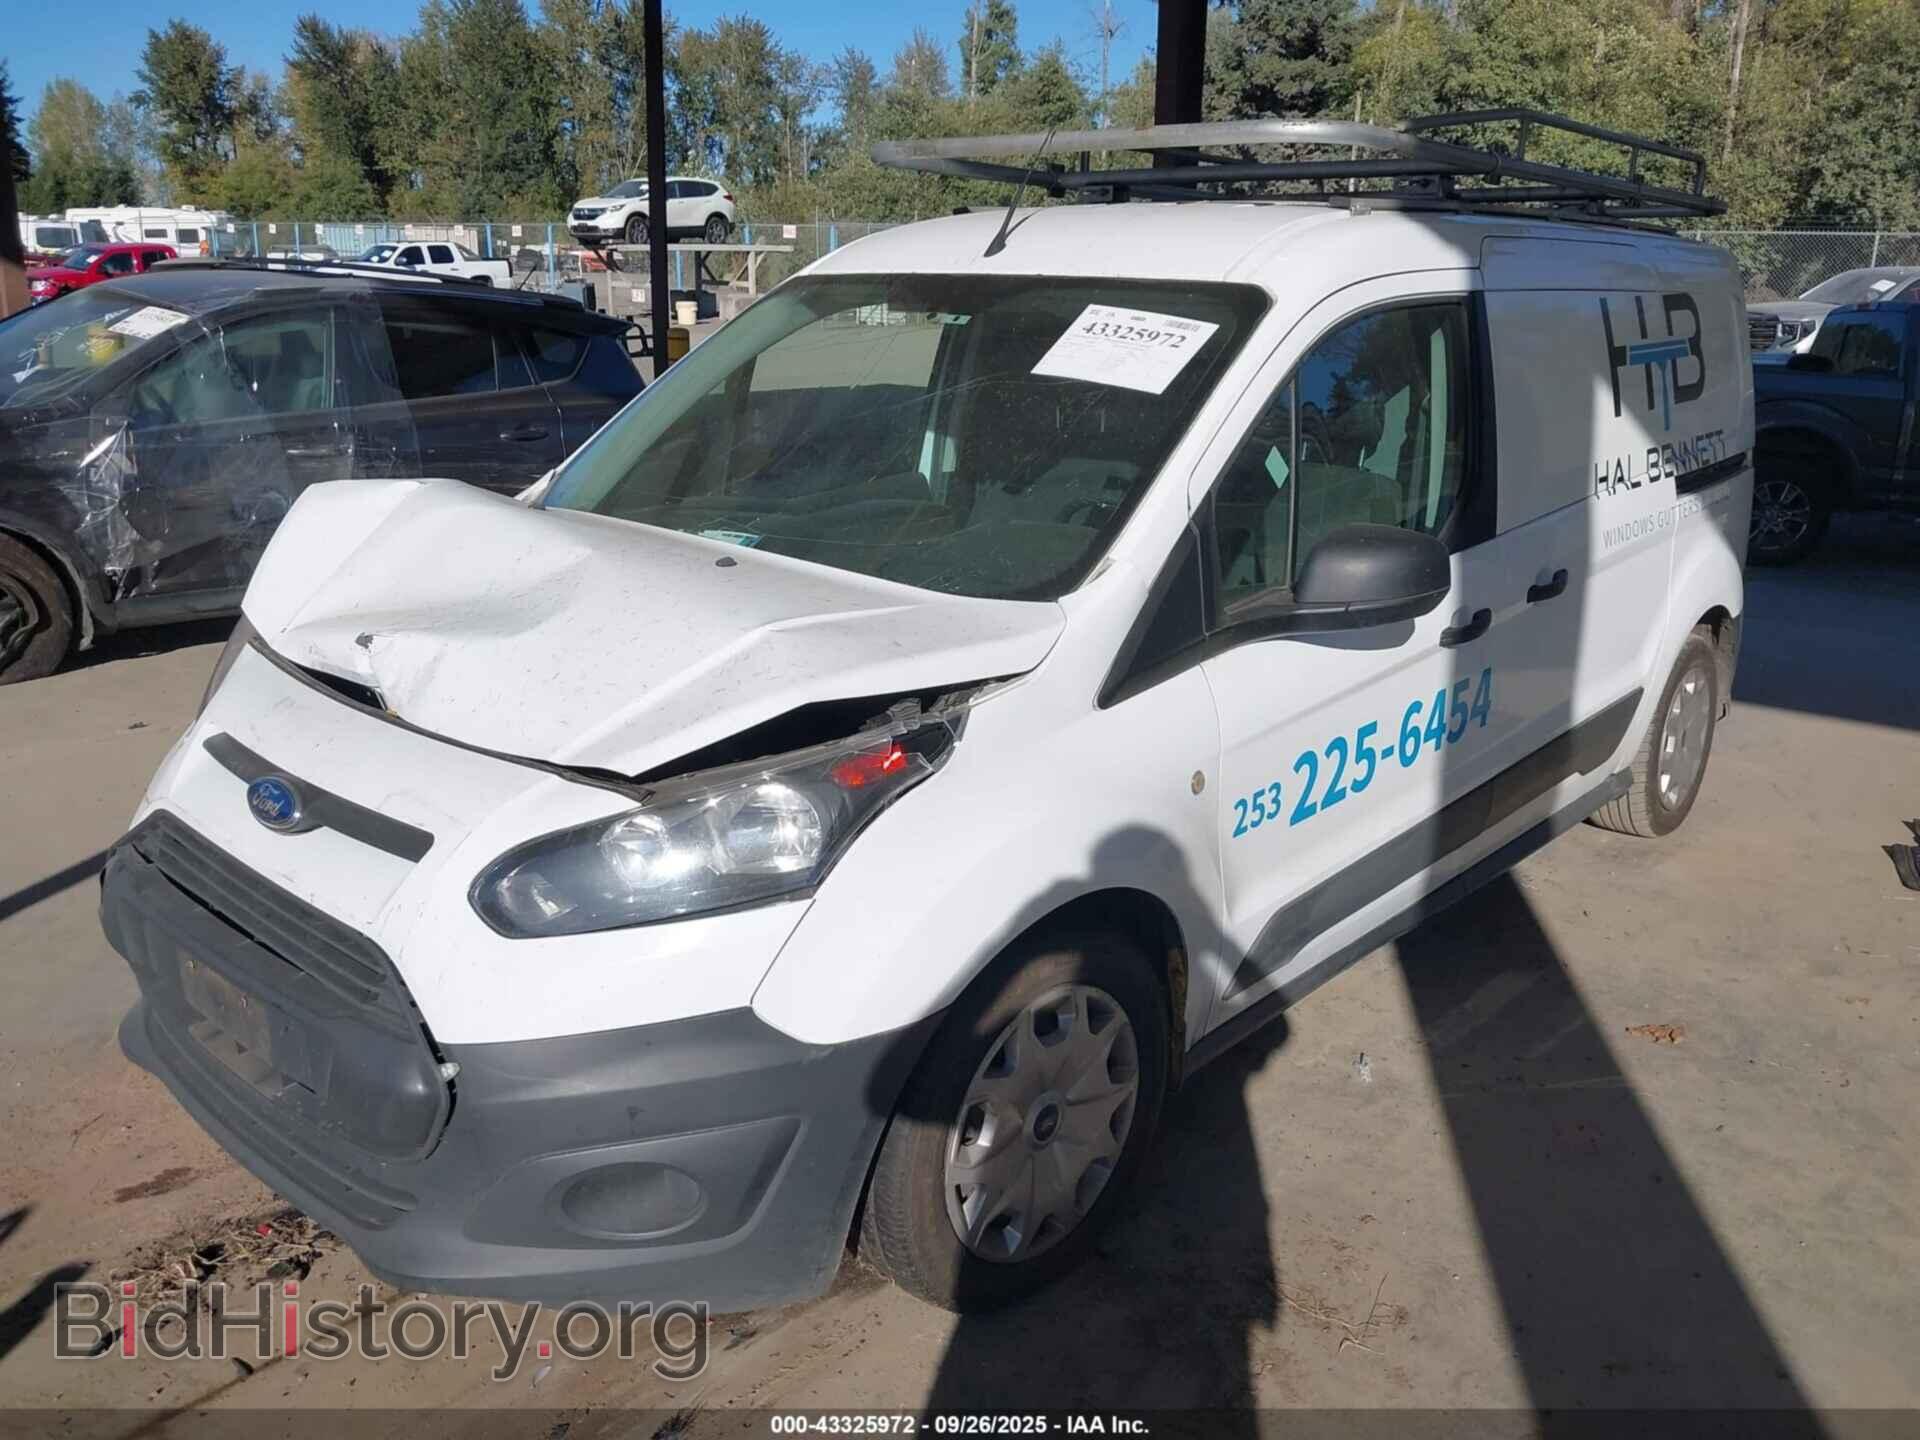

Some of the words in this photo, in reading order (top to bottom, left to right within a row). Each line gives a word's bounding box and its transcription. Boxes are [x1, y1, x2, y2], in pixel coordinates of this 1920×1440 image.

[1082, 322, 1187, 348] 43325972
[1594, 454, 1641, 499] HAL
[1647, 429, 1726, 483] BENNETT
[1602, 514, 1655, 548] WINDOWS
[1232, 782, 1282, 838] 253
[1289, 667, 1492, 827] 225-6454
[252, 783, 285, 817] Ford
